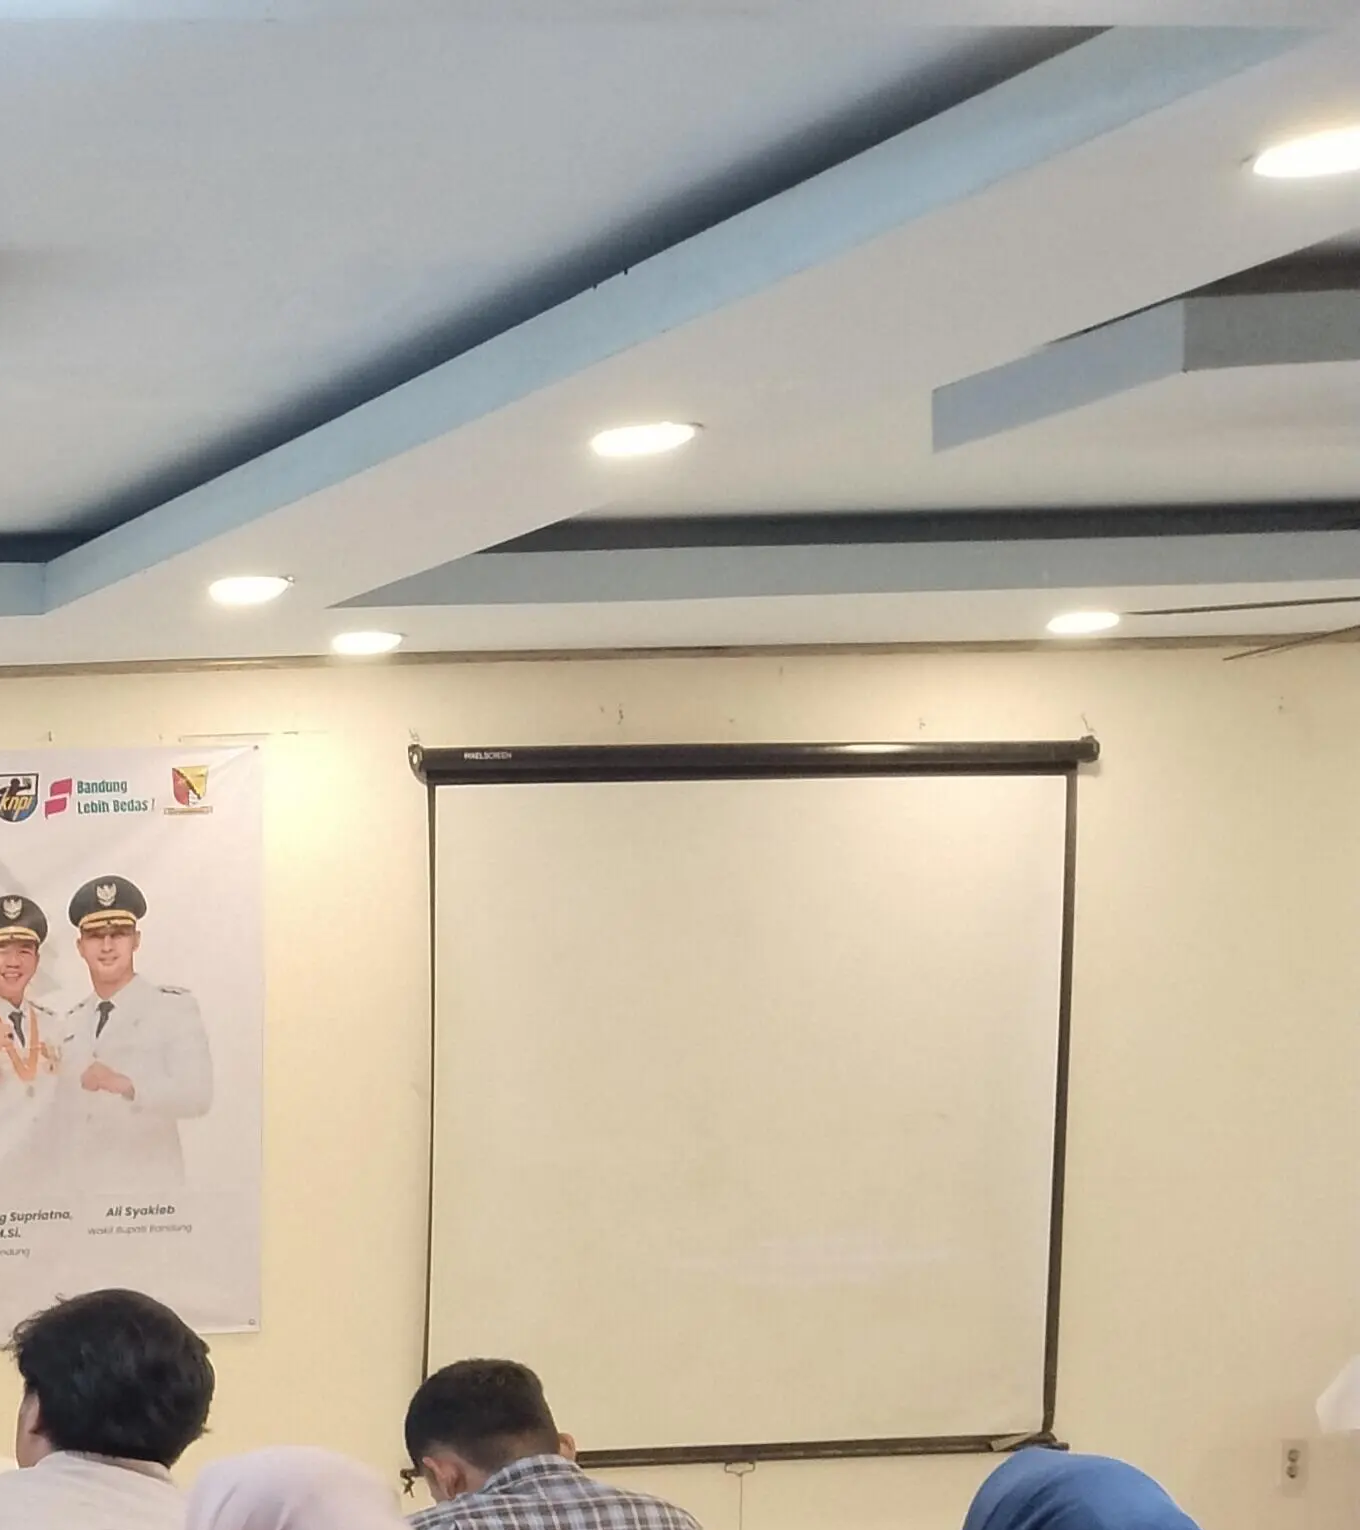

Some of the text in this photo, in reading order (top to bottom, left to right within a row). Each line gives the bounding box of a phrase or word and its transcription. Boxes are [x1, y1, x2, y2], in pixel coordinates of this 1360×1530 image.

[77, 780, 128, 794] Bandung
[77, 801, 111, 815] Lebih
[113, 799, 148, 813] Bedas
[105, 1204, 175, 1219] Ali Syakieb
